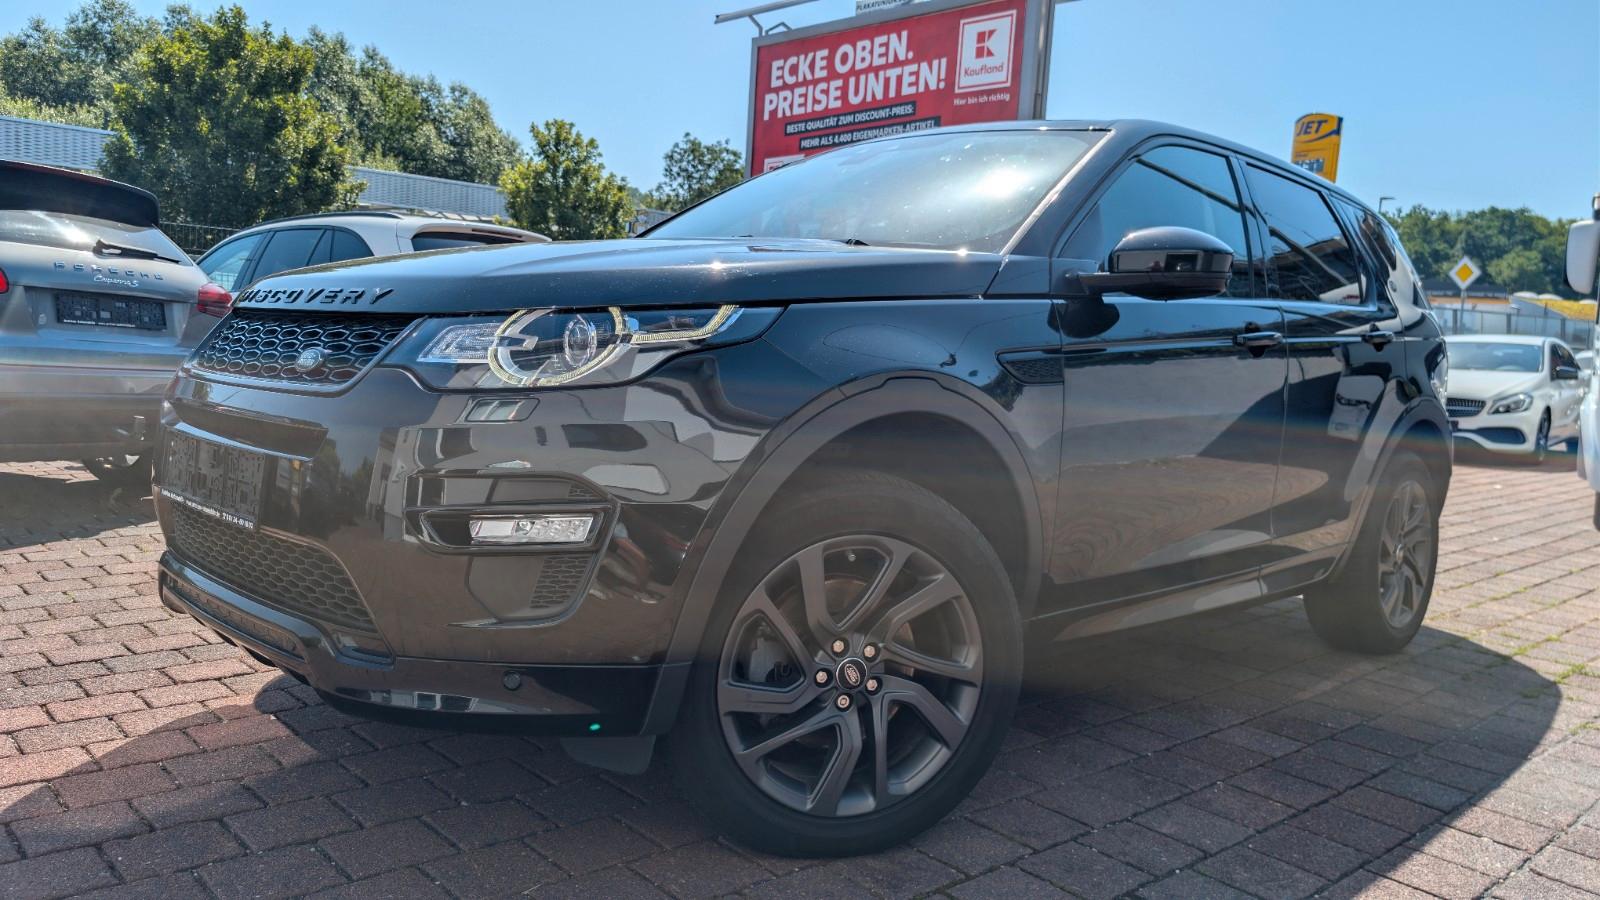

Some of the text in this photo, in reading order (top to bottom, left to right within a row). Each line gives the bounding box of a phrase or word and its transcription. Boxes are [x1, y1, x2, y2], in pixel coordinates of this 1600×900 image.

[771, 31, 913, 88] ECKE OBEN.
[964, 62, 1004, 77] Kaufland
[763, 57, 948, 121] PREISE UNTEN!
[967, 96, 978, 104] bin
[978, 94, 988, 103] ich
[989, 92, 1010, 102] richtig
[786, 104, 914, 134] BESTE QUALITÄT ZUM DISCOUNT-PREIS:
[1296, 119, 1328, 136] JET
[801, 137, 820, 149] MEHR
[820, 135, 834, 146] ALS
[239, 288, 394, 305] DISCOVERY
